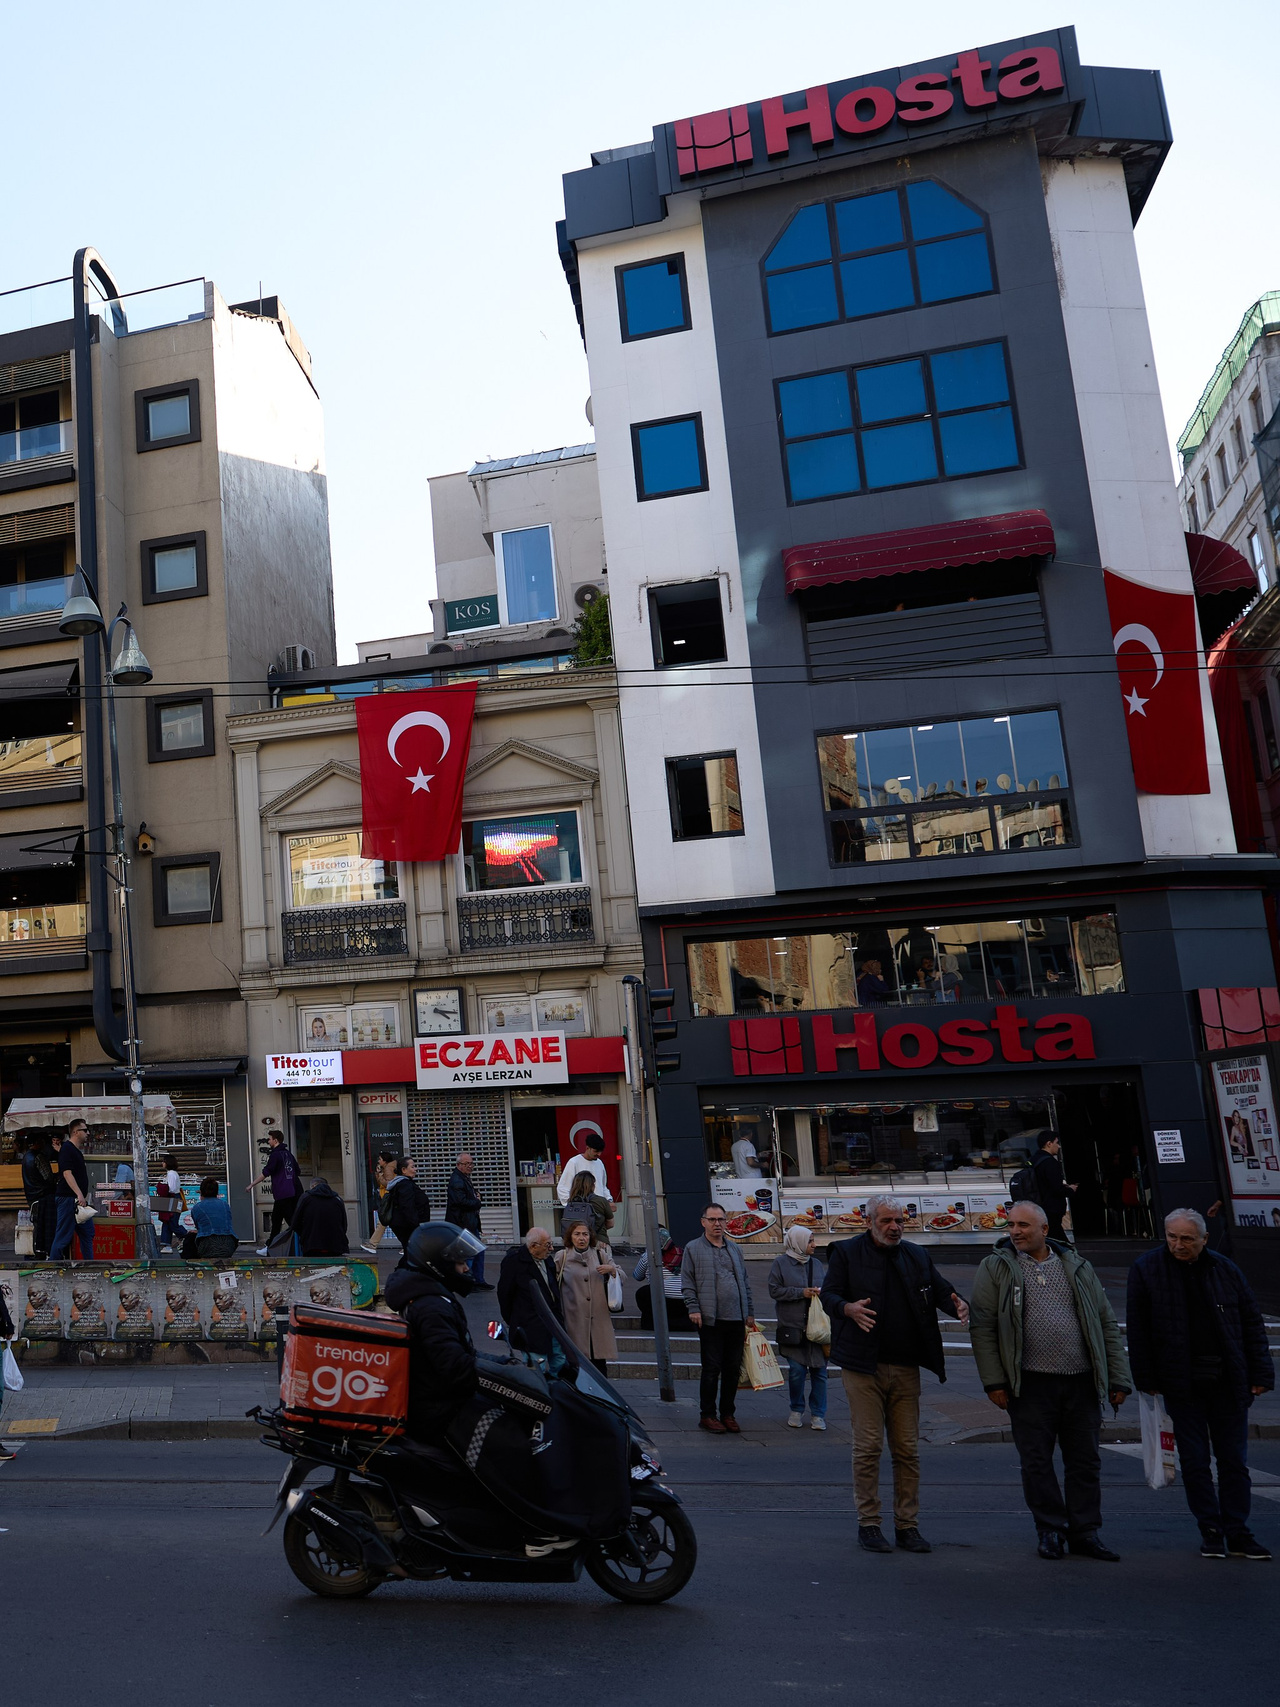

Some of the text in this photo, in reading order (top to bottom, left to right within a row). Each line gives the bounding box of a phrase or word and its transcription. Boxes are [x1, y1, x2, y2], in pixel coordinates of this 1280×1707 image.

[761, 47, 1064, 158] Hosta
[455, 602, 491, 620] KOS
[310, 860, 356, 871] Titcotour
[341, 874, 354, 883] 70
[811, 1004, 1097, 1072] Hosta
[419, 1036, 562, 1069] ECZANE
[272, 1055, 335, 1069] Titcotour
[286, 1068, 300, 1077] 444
[302, 1069, 310, 1077] 70
[452, 1069, 533, 1083] AYŞE LERZAN
[359, 1092, 399, 1104] OPTİK
[1238, 1210, 1267, 1227] mavi
[95, 1240, 128, 1255] MİT
[315, 1342, 390, 1367] trendyol
[312, 1365, 389, 1408] go
[491, 1382, 516, 1399] ELEVEN
[514, 1390, 545, 1412] DEGREES
